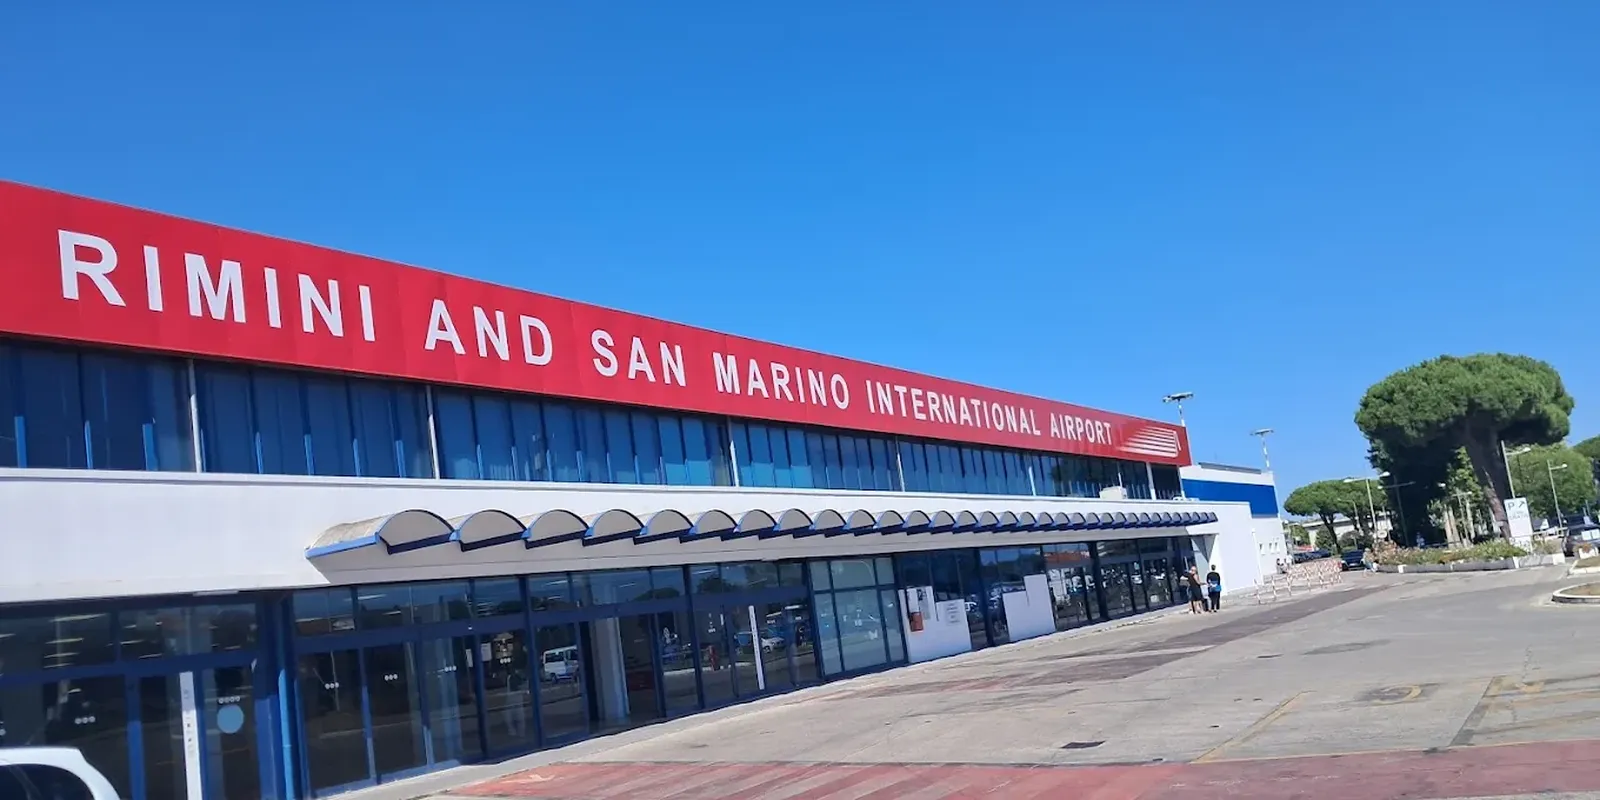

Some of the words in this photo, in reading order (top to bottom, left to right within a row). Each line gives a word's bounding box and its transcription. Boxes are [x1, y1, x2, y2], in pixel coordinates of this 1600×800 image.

[58, 229, 376, 342] RIMINI
[424, 299, 553, 366] AND
[591, 329, 686, 386] SAN
[712, 352, 850, 409] MARINO
[865, 379, 1042, 436] INTERNATIONAL
[1050, 412, 1112, 445] AIRPORT
[1507, 501, 1515, 510] P
